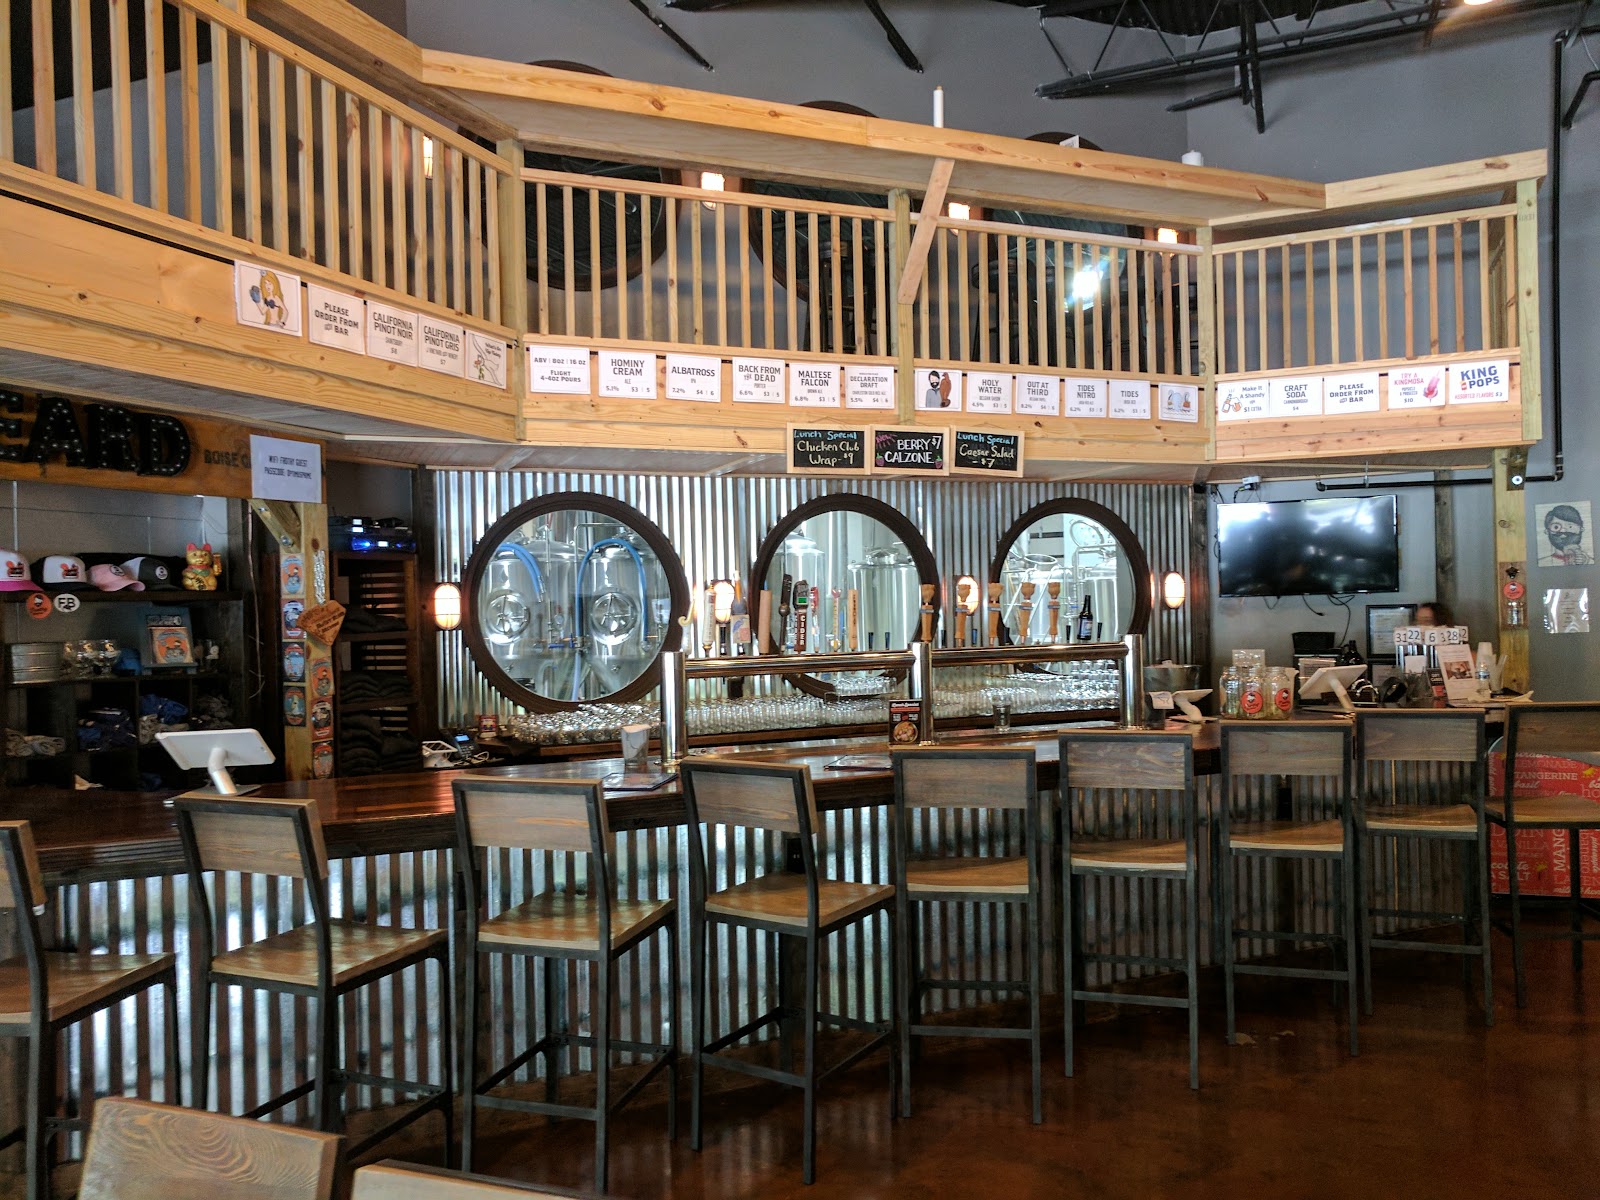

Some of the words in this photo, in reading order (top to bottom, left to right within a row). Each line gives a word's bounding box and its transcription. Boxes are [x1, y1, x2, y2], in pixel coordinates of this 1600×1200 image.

[324, 302, 350, 317] PLEASE
[315, 310, 337, 323] ORDER
[340, 316, 359, 329] FROM
[373, 311, 414, 331] CALIFORNIA
[334, 325, 349, 336] BAR
[374, 321, 397, 336] PINOT
[397, 328, 414, 340] NOIR
[423, 325, 460, 344] CALIFORNIA
[424, 335, 444, 348] PINOT
[445, 340, 460, 352] GRIS
[611, 358, 645, 368] HOMINY
[550, 369, 571, 377] FLIGHT
[612, 367, 643, 377] CREAM
[671, 366, 716, 377] ALBATROSS
[738, 364, 759, 374] BACK
[760, 366, 781, 375] FROM
[798, 370, 832, 379] MALTESE
[1460, 365, 1498, 381] KING
[754, 373, 776, 383] DEAD
[800, 378, 829, 387] FALCON
[849, 375, 889, 383] DECLARATION
[981, 378, 1000, 387] HOLY
[1468, 375, 1500, 389] POPS
[1027, 380, 1040, 388] OUT
[1077, 384, 1095, 392] TIDES
[1284, 384, 1309, 392] CRAFT
[1339, 383, 1364, 391] PLEASE
[978, 386, 1002, 394] WATER
[1026, 388, 1049, 396] THIRD
[1076, 391, 1096, 399] NITRO
[1120, 390, 1139, 398] TIDES
[1286, 390, 1306, 399] SODA
[1329, 390, 1353, 398] ORDER
[794, 430, 822, 439] Lunch
[827, 431, 858, 441] Special
[957, 432, 985, 443] Lunch
[986, 435, 1014, 446] Special
[797, 440, 838, 452] Chicken
[839, 441, 860, 451] Club
[897, 439, 931, 451] BERRY
[931, 435, 942, 450] $7
[959, 443, 990, 457] Caesar
[991, 445, 1014, 459] Salad
[204, 449, 239, 468] BOISE
[884, 451, 935, 464] CALZONE
[981, 458, 995, 468] $7
[1408, 629, 1420, 640] 22
[1429, 632, 1436, 642] 6
[1446, 630, 1458, 641] 28
[1514, 760, 1578, 769] LEMONADE
[1513, 772, 1578, 781] TANGERINE
